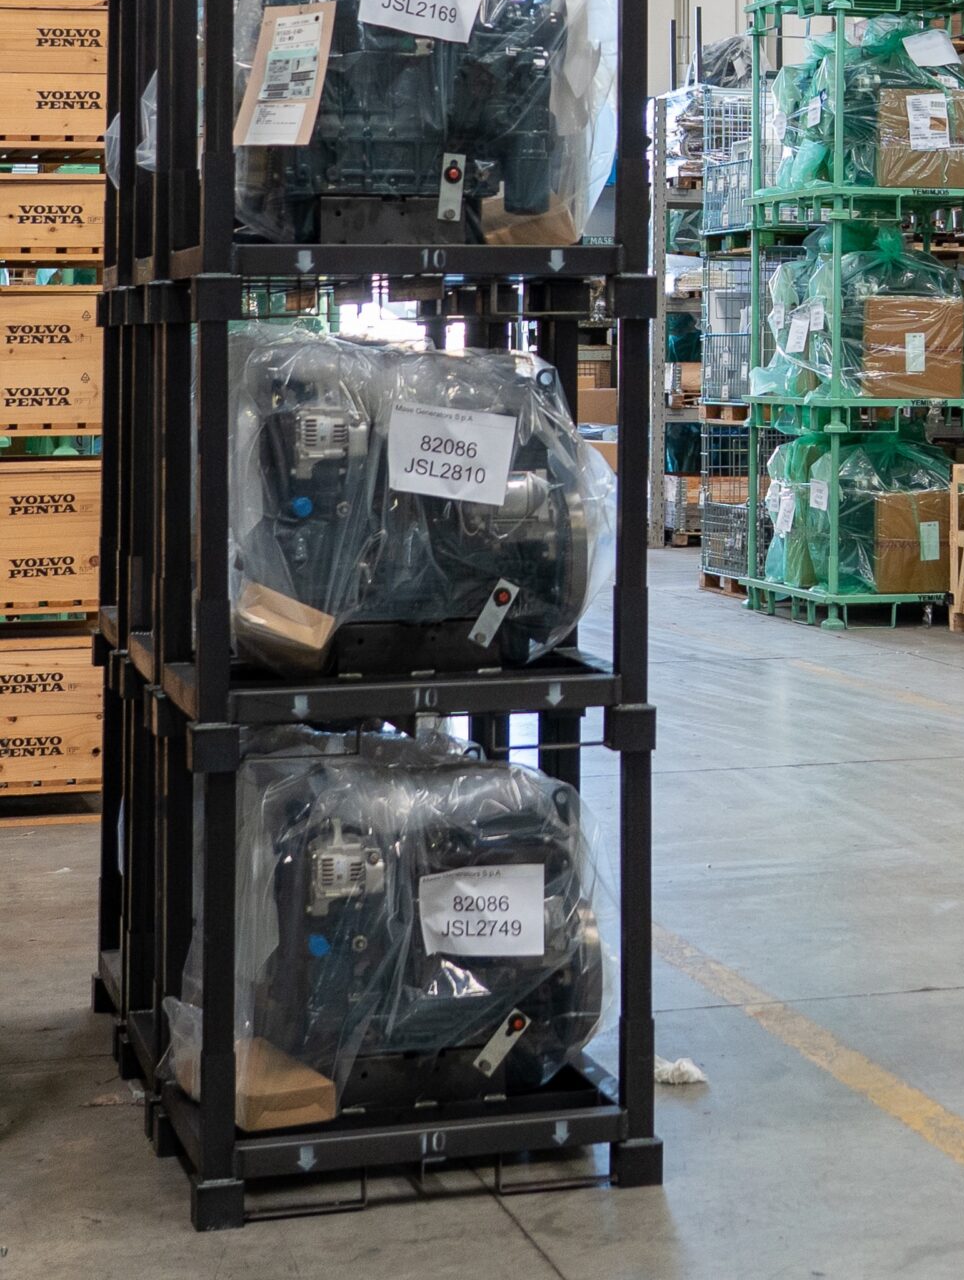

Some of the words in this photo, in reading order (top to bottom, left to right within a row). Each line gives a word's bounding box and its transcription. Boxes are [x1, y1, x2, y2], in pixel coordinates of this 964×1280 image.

[36, 28, 101, 37] VOLVO
[36, 38, 103, 47] PENTA
[36, 91, 101, 101] VOLVO
[36, 101, 103, 109] PENTA
[19, 205, 83, 214] VOLVO
[18, 215, 85, 224] PENTA
[421, 248, 446, 269] 10
[6, 324, 71, 334] VOLVO
[5, 334, 72, 344] PENTA
[4, 387, 70, 397] VOLVO
[4, 397, 72, 407] PENTA
[420, 435, 478, 458] 82086
[404, 458, 486, 484] JSL2810
[10, 494, 76, 505] VOLVO
[9, 504, 77, 515] PENTA
[9, 556, 75, 568] VOLVO
[9, 566, 77, 578] PENTA
[0, 672, 64, 683] VOLVO
[0, 683, 66, 694] PENTA
[413, 687, 438, 709] 10
[0, 736, 62, 747] VOLVO
[0, 746, 64, 757] PENTA
[453, 895, 510, 912] 82086
[441, 920, 522, 937] JSL2749
[421, 1131, 446, 1154] 10
